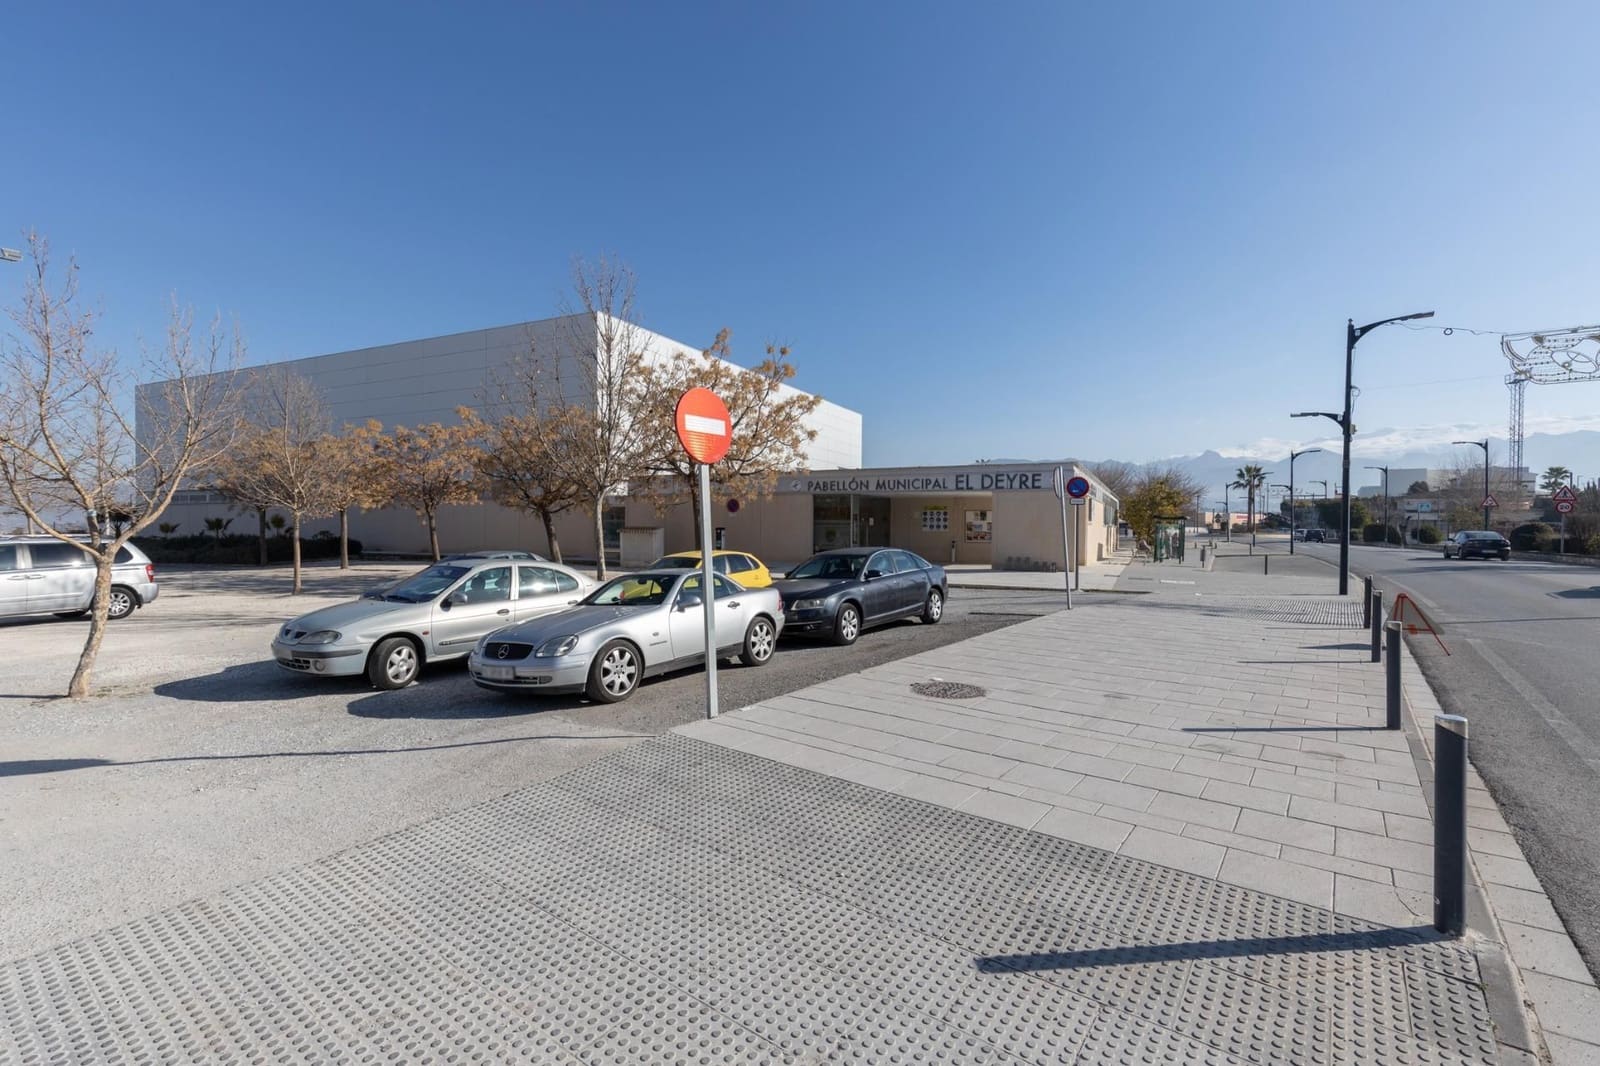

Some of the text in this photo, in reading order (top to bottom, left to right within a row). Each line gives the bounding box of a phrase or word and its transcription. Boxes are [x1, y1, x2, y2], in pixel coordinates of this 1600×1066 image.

[807, 473, 1042, 491] PABELLÓN MUNICIPAL EL DEYRE
